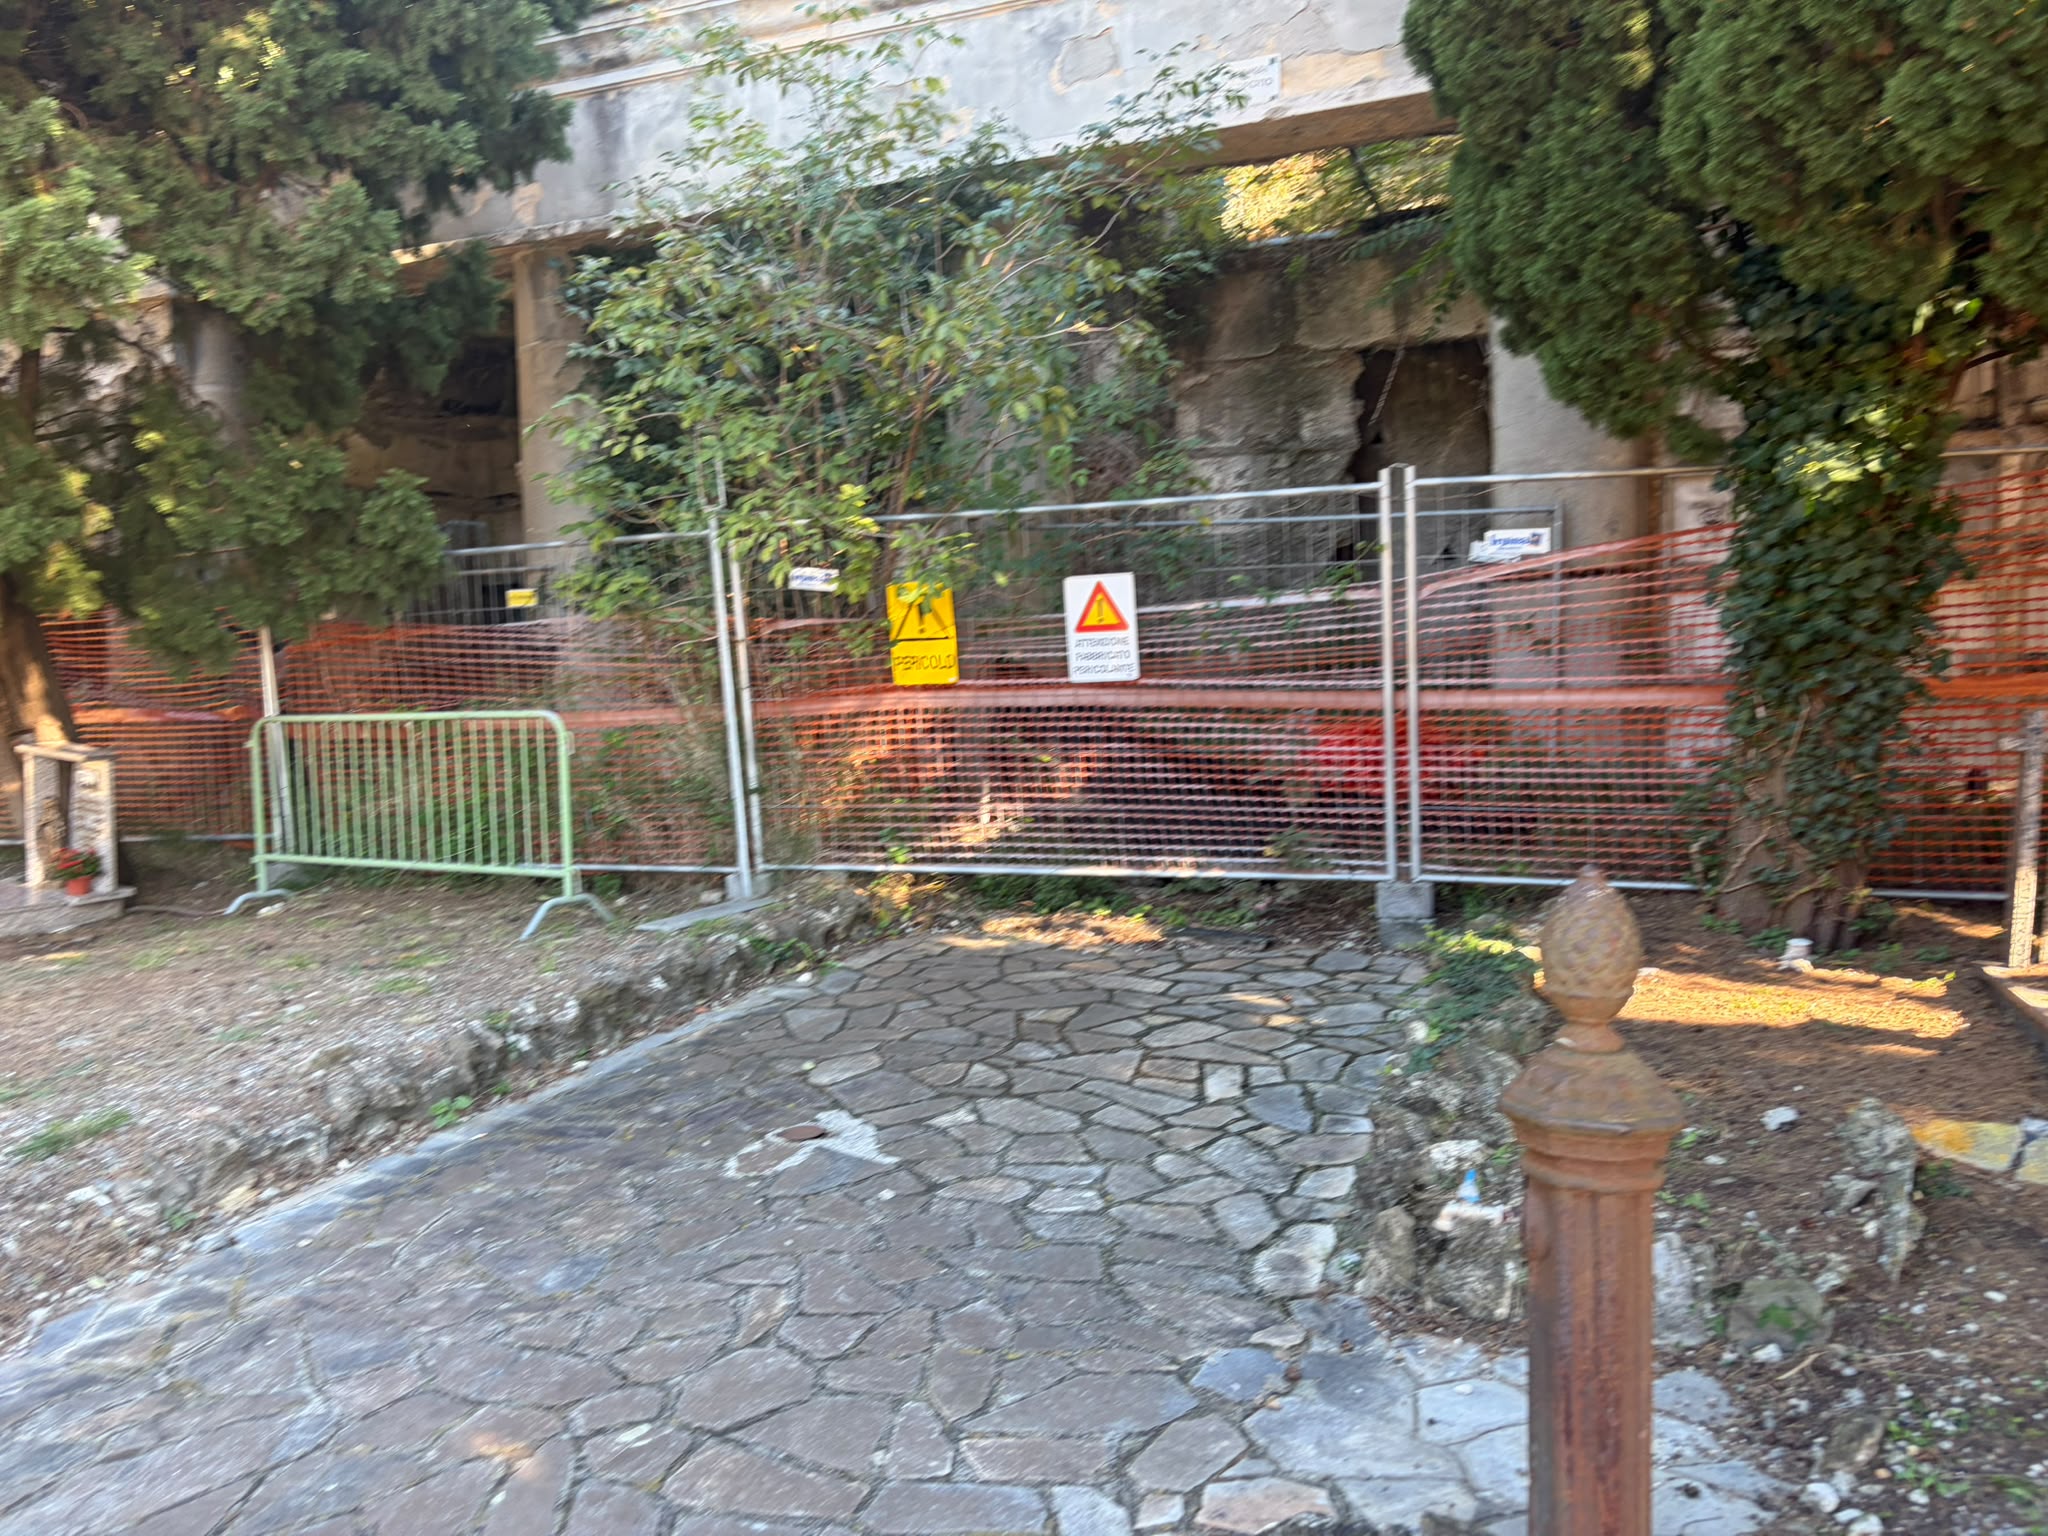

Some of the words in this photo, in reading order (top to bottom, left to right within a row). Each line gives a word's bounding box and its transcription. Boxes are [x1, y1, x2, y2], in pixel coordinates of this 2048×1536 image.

[1075, 636, 1130, 648] ATTENZIONE
[1075, 649, 1131, 661] FABBRICATO
[893, 654, 956, 671] PERICOLO
[1072, 662, 1136, 675] PERICOLANTE
